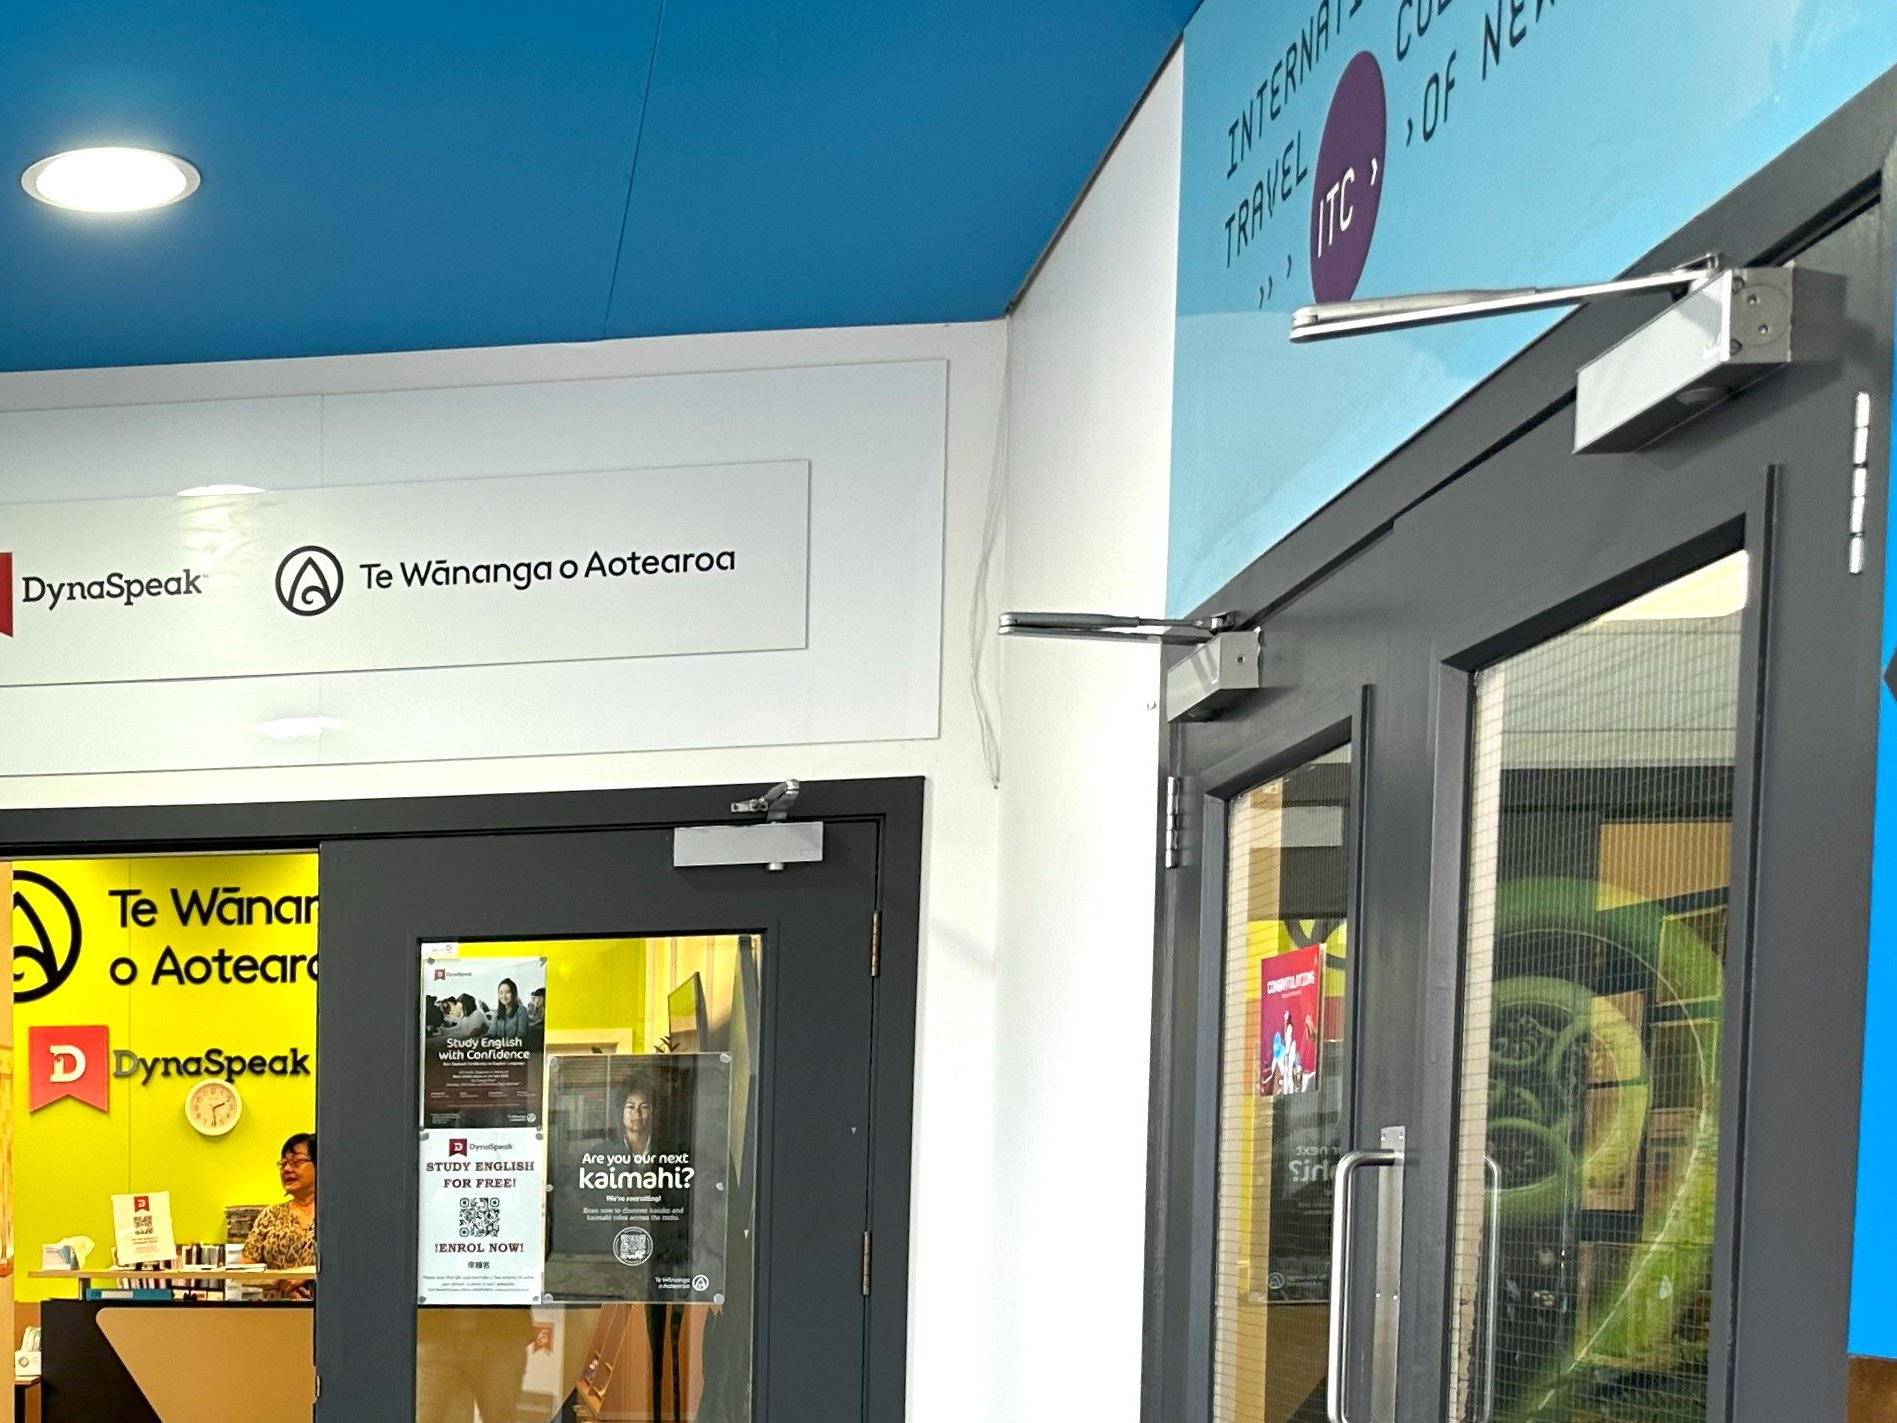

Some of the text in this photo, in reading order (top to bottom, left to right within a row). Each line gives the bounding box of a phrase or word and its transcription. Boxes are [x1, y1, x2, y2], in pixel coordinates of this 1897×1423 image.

[1396, 0, 1454, 62] CO
[1421, 49, 1457, 142] OF
[1224, 130, 1308, 269] TRAVEL
[1317, 167, 1355, 258] ITC
[359, 550, 736, 591] Te Wānanga o Aotearoa
[22, 568, 203, 611] DynaSpeak
[108, 889, 158, 928] Te
[109, 957, 138, 986] o
[439, 1049, 530, 1060] with Confidence
[446, 1037, 523, 1049] Study English
[112, 1047, 311, 1086] DynaSpeak
[469, 1143, 513, 1151] DynaSpeak
[582, 1153, 689, 1166] Are you our next
[426, 1161, 535, 1172] STUDY ENGLISH
[579, 1166, 695, 1189] kaimahi?
[443, 1178, 516, 1189] FOR FREE!
[489, 1243, 524, 1253] NOW!
